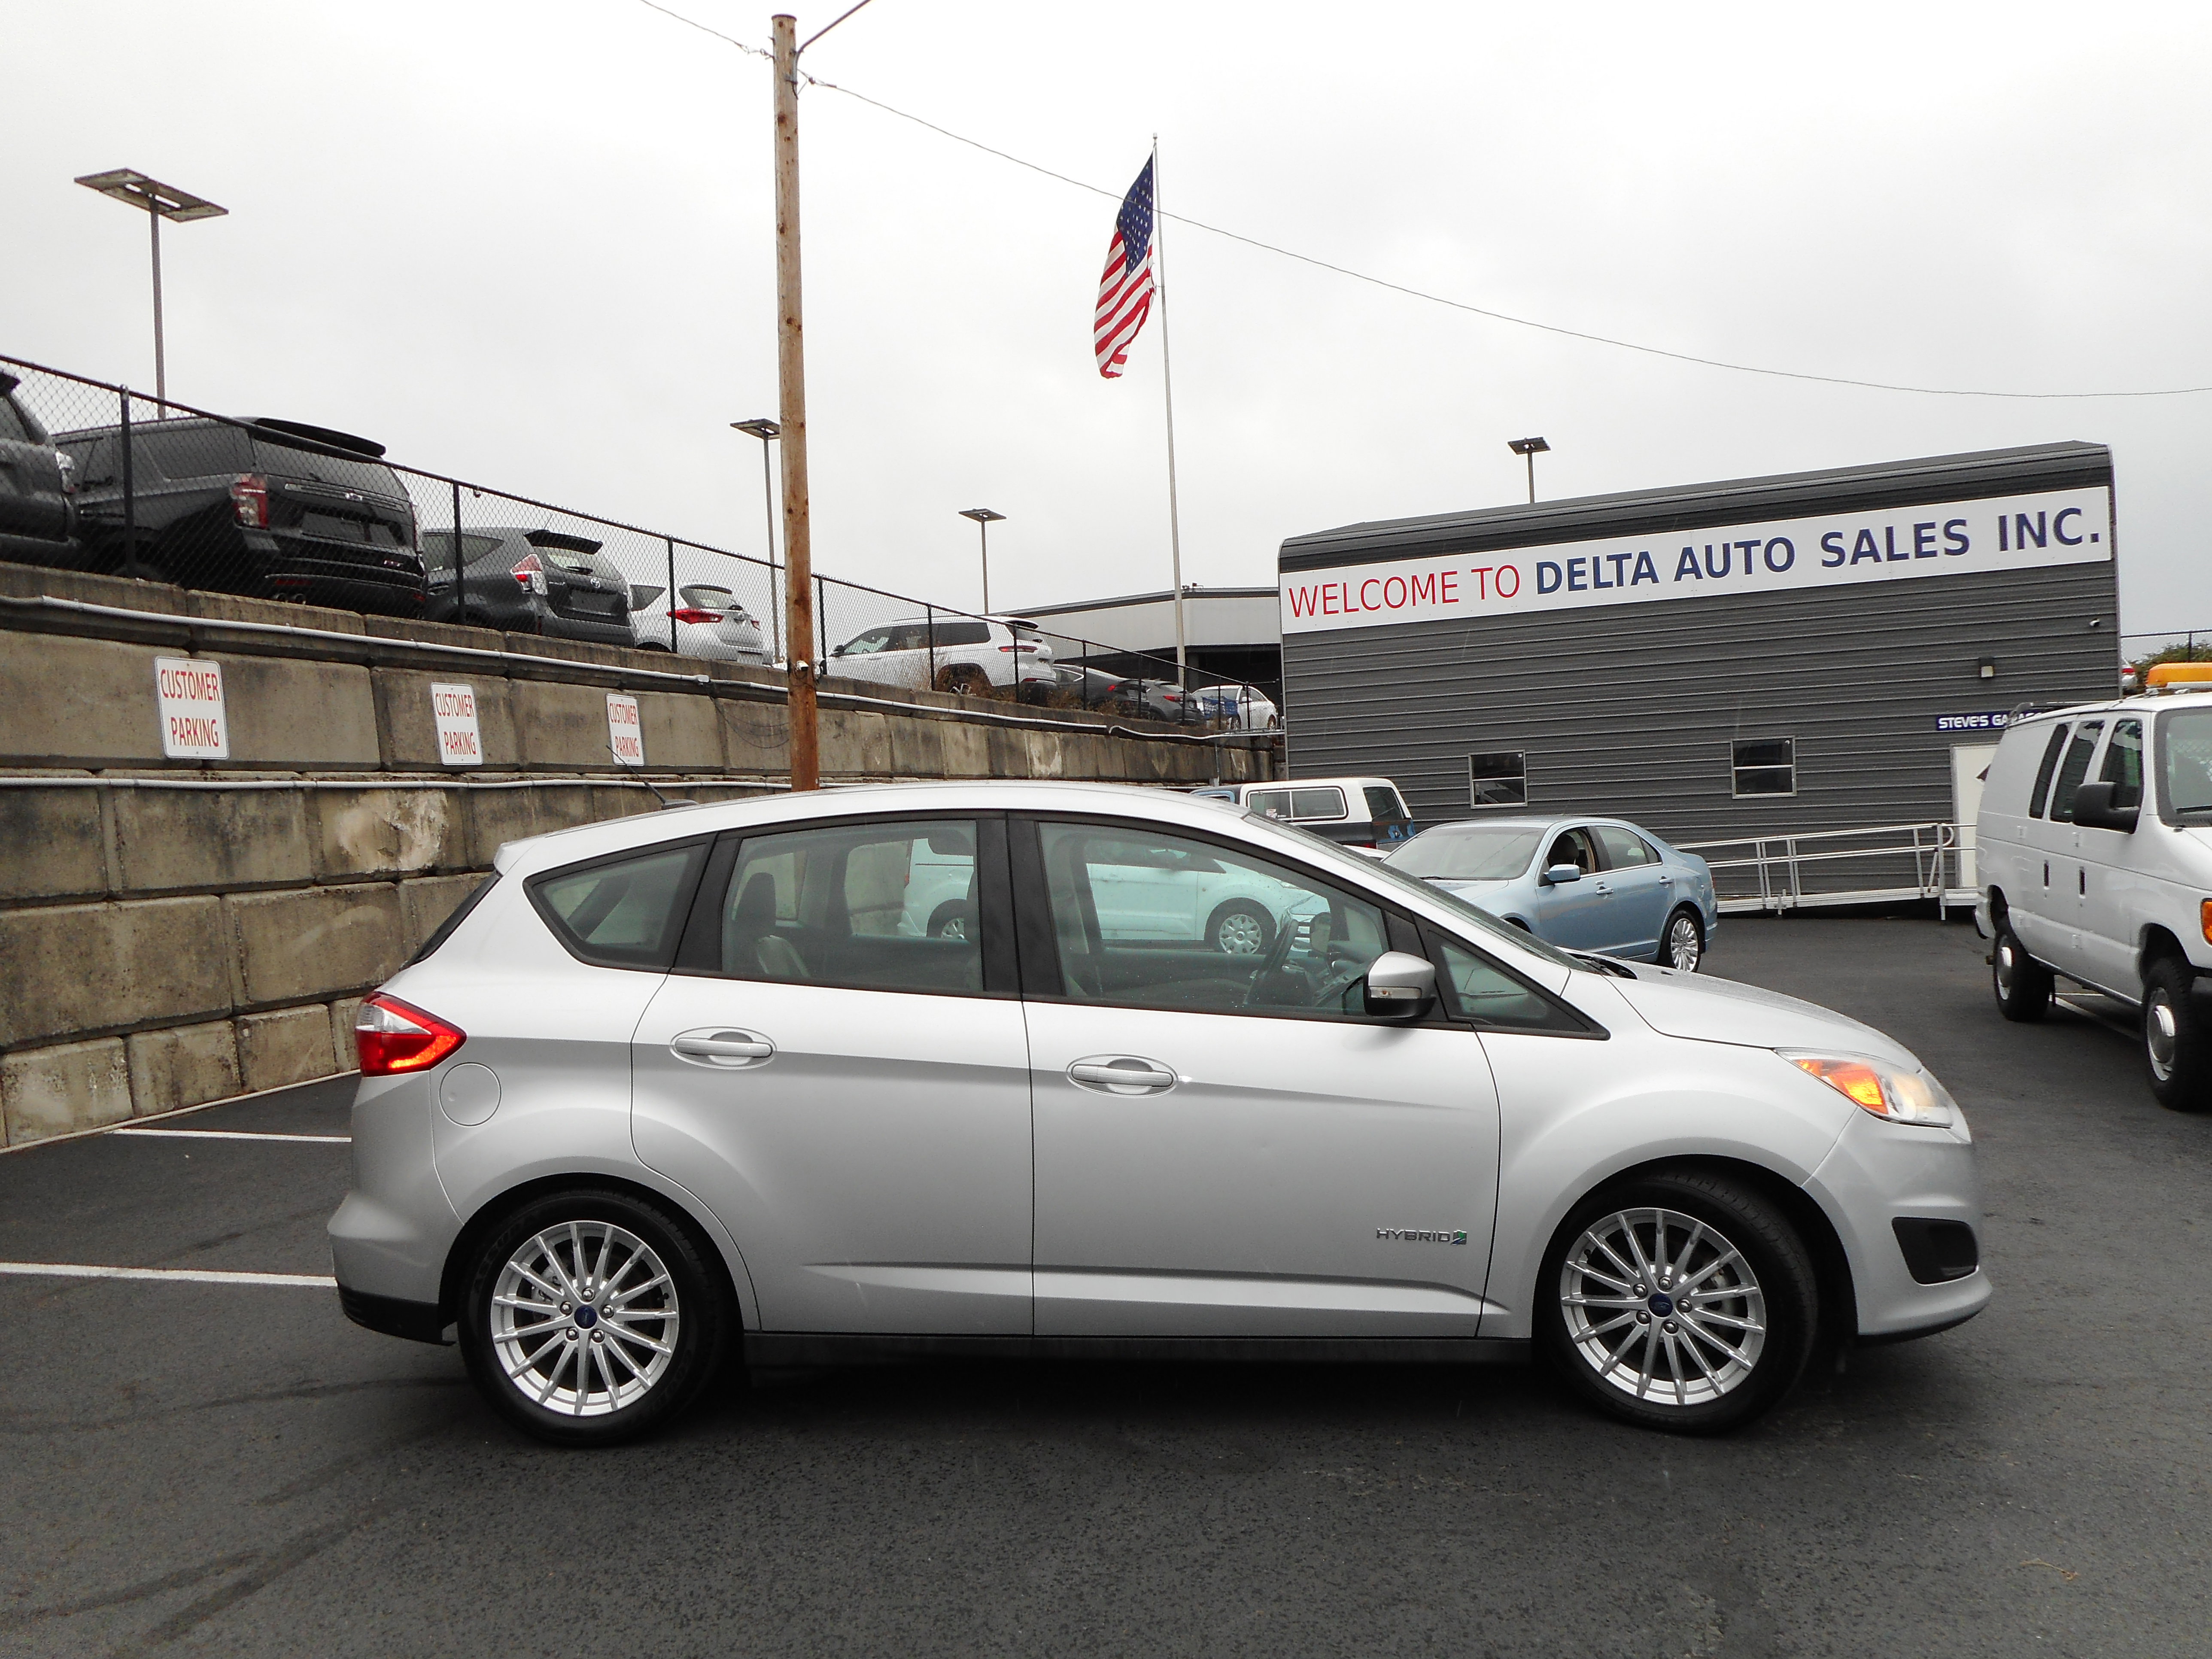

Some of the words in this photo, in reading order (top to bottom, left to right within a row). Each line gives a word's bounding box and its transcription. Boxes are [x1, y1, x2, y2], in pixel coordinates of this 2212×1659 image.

[1288, 571, 1460, 617] WELCOME
[1471, 565, 1520, 600] TO
[1537, 551, 1660, 594] DELTA
[1674, 536, 1795, 582] AUTO
[1821, 519, 1970, 568] SALES
[1999, 507, 2100, 552] INC.
[160, 668, 220, 701] CUSTOMER
[435, 693, 474, 717] CUSTOMER
[609, 702, 638, 725] CUSTOMER
[170, 717, 219, 747] PARKING
[1939, 715, 1989, 729] STEVE'S
[444, 731, 477, 755] PARKING
[614, 735, 639, 757] PARKING
[1376, 1228, 1451, 1243] HYBRID
